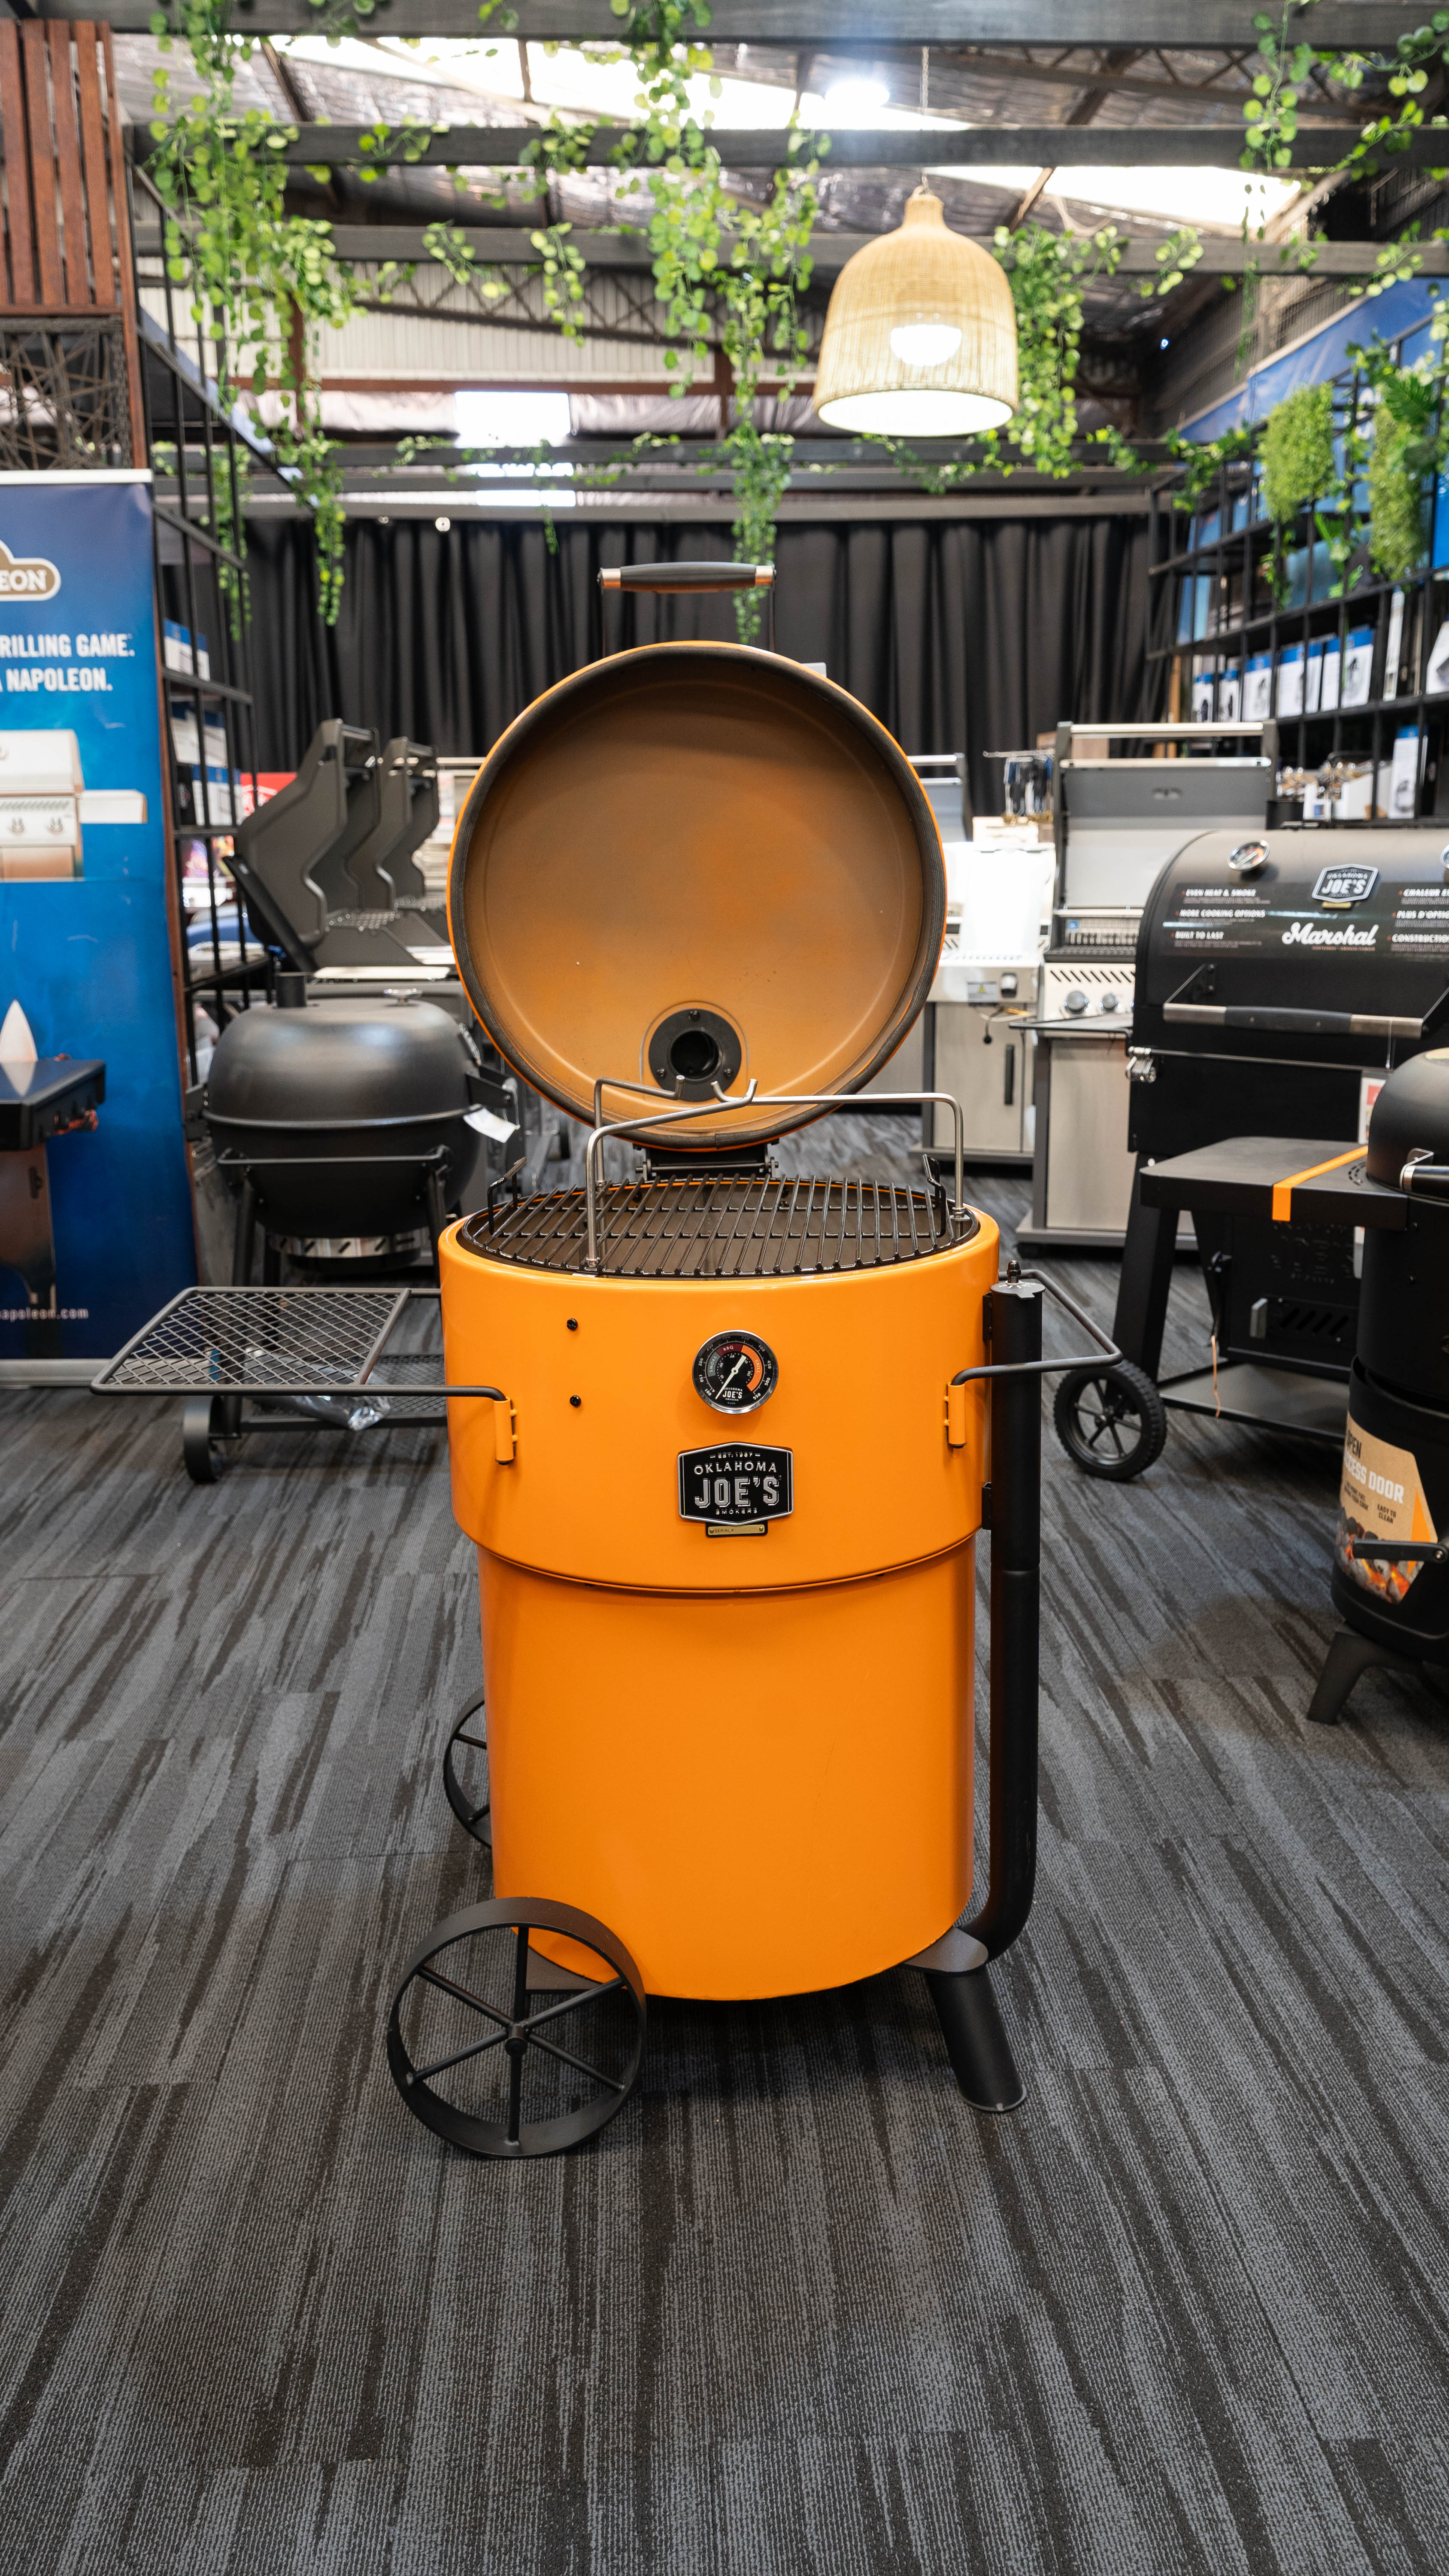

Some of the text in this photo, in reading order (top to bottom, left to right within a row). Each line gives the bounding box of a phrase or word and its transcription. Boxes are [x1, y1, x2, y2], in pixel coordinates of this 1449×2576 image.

[76, 634, 135, 657] GAME.
[6, 668, 113, 692] NAPOLEON.
[1185, 889, 1204, 897] EVEN
[1204, 889, 1223, 897] HEAT
[1231, 889, 1257, 897] SMOKE
[1321, 879, 1366, 894] JOE'S
[1403, 889, 1440, 897] CHALEUR
[1179, 909, 1266, 918] MORE COOKING OPTIONS
[1396, 910, 1416, 919] PLUS
[1175, 931, 1195, 939] BUILT
[1206, 931, 1224, 939] LAST
[1282, 922, 1379, 945] Marshal
[1391, 934, 1449, 943] CONSTRUCTIO
[0, 1306, 88, 1323] apoleon.com
[722, 1391, 743, 1399] JOE'S
[694, 1461, 777, 1475] OKLAHOMA
[694, 1476, 779, 1508] JOE'S
[1368, 1470, 1404, 1504] DOOR
[1377, 1504, 1397, 1518] EASY TO
[1379, 1512, 1394, 1524] CLEAN
